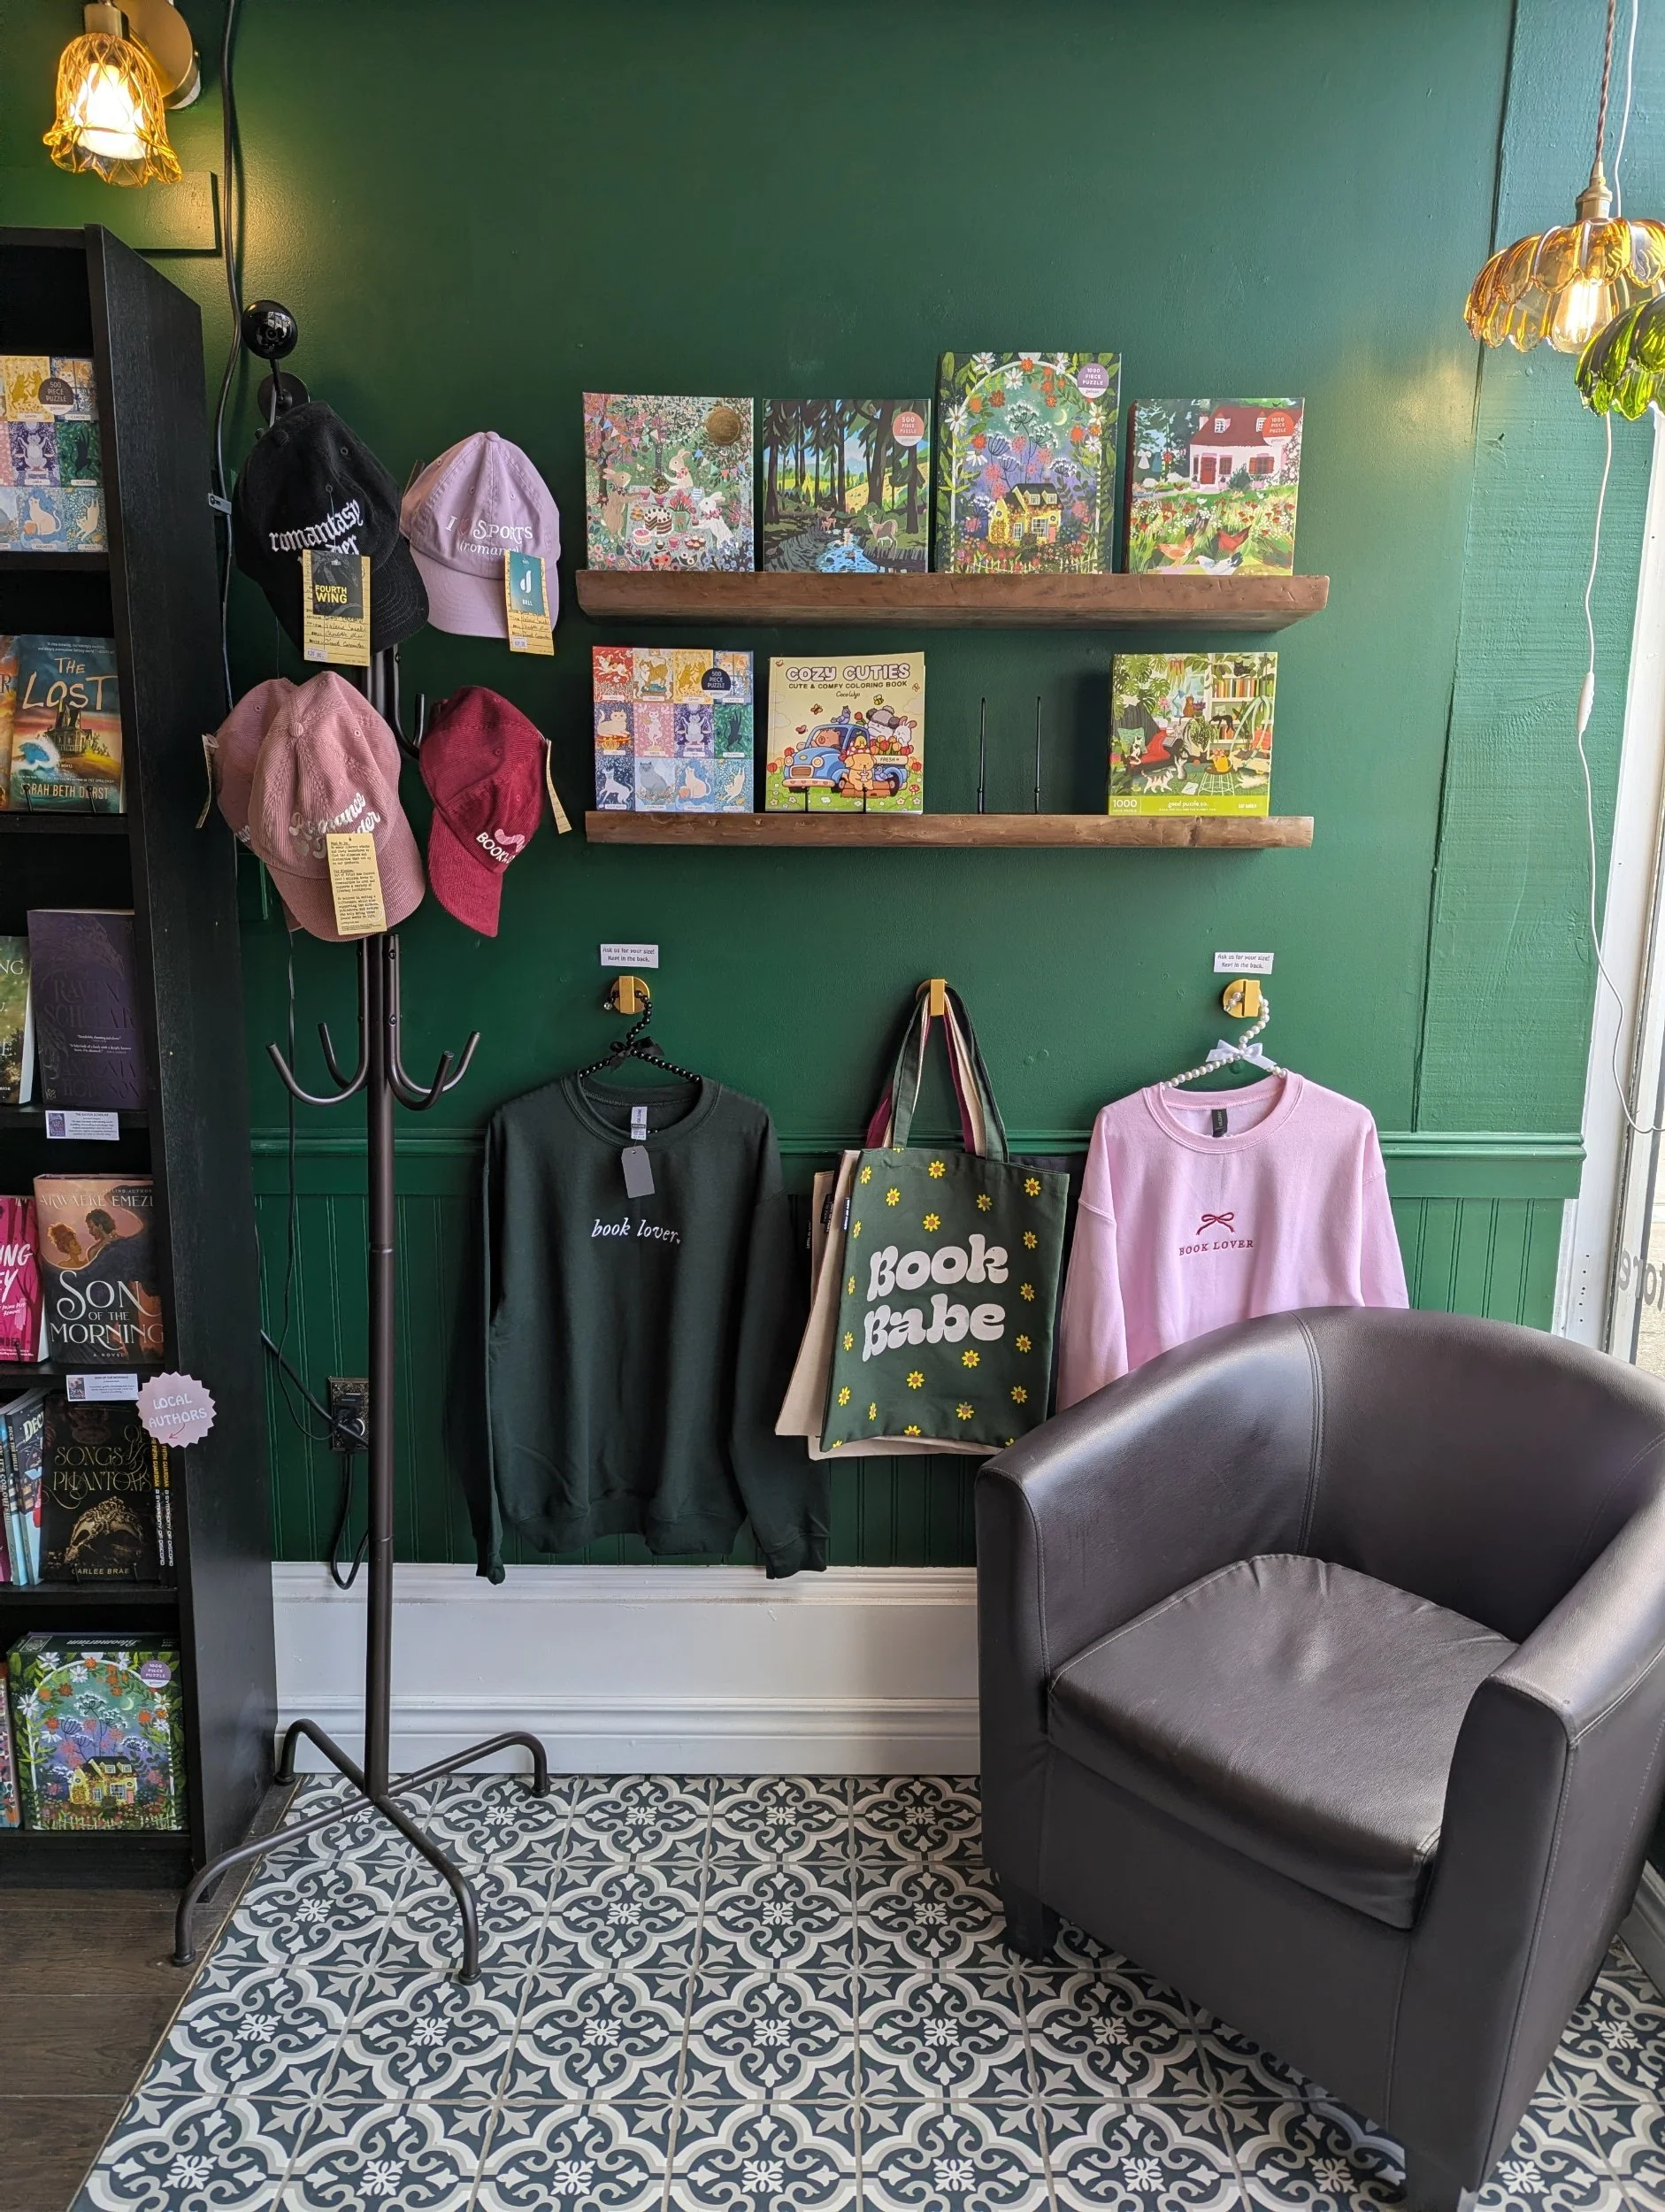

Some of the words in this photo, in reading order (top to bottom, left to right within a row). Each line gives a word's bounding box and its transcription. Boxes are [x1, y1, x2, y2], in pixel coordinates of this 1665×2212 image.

[269, 499, 364, 552] romantasy
[315, 585, 347, 594] FOURTH
[315, 593, 348, 603] WING
[54, 657, 86, 674] THE
[786, 666, 837, 682] COZY
[843, 663, 910, 681] CUTIES
[22, 671, 119, 710] LOST
[20, 784, 50, 796] SRAH
[53, 785, 75, 797] BETH
[112, 1195, 154, 1207] EMEZI
[591, 1217, 631, 1239] book
[1179, 1241, 1208, 1256] BOOK
[1213, 1239, 1254, 1251] LOVER
[57, 1270, 163, 1321] SON
[88, 1311, 104, 1321] OF
[108, 1311, 131, 1321] THE
[50, 1323, 165, 1351] MORNING
[152, 1394, 193, 1410] LOCAL
[22, 1410, 43, 1442] DEC
[149, 1408, 208, 1428] AUTHORS
[55, 1446, 123, 1466] SONGS
[53, 1471, 152, 1493] PHANTOMS
[66, 1639, 139, 1647] Bloomarium
